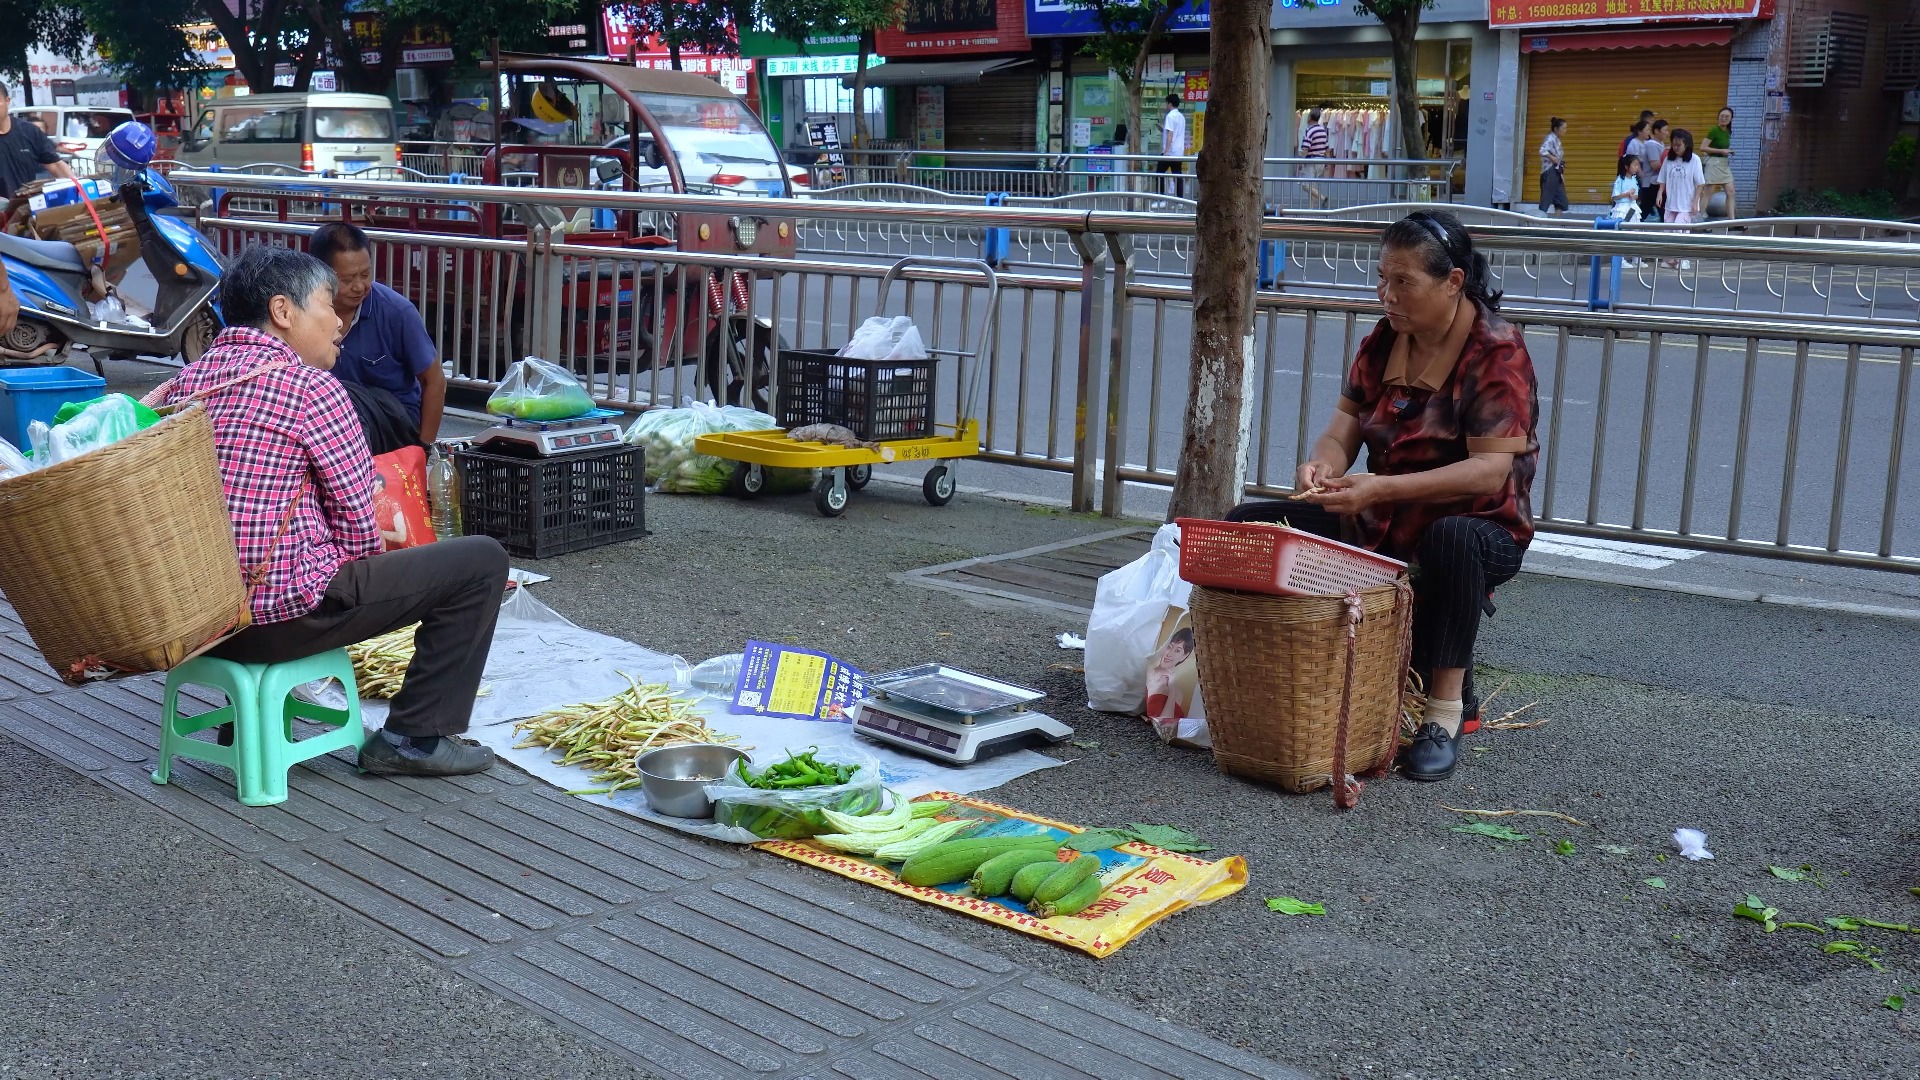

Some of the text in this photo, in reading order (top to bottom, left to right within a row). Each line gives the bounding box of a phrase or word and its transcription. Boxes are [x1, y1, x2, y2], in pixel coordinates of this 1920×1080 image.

[1528, 2, 1597, 18] 15908268428
[711, 58, 752, 71] 家常小炒
